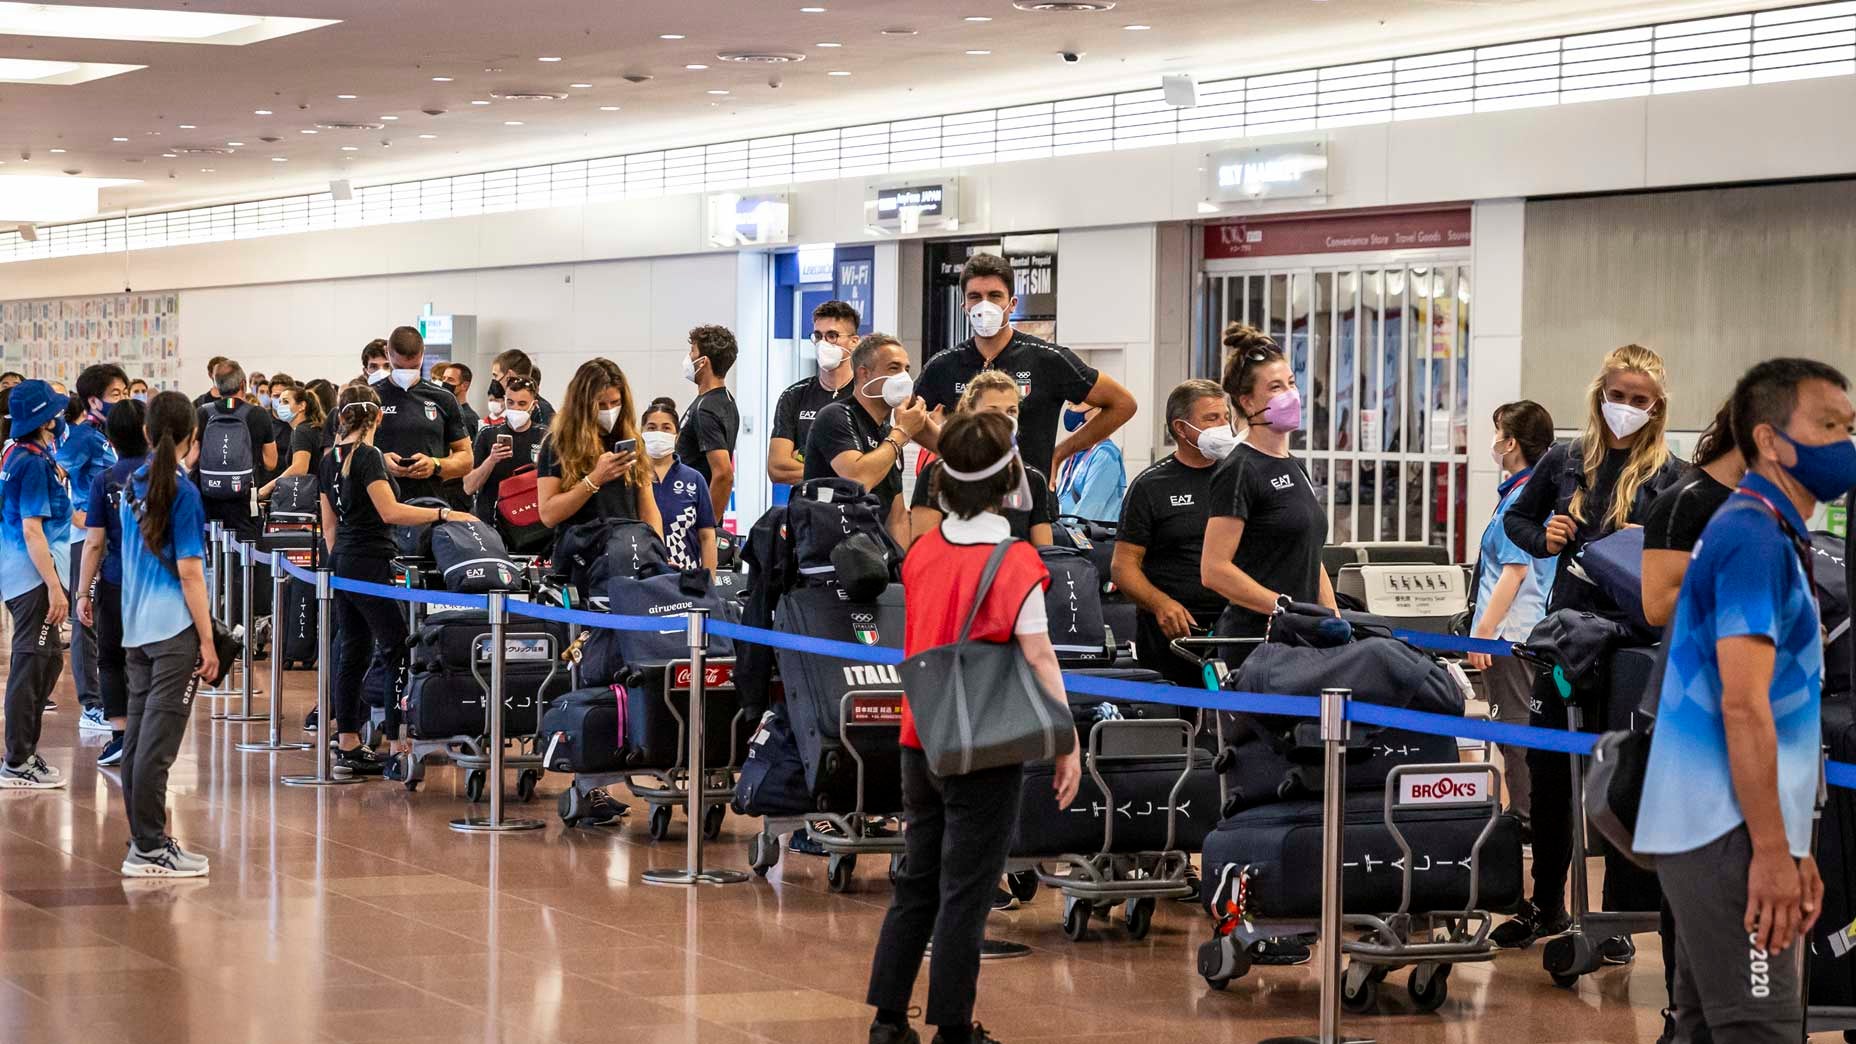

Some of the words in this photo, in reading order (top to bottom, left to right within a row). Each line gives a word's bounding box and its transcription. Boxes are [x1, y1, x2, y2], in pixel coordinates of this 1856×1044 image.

[1326, 235, 1369, 248] Convenience
[1371, 232, 1389, 245] Store
[1395, 231, 1416, 243] Travel
[1418, 230, 1441, 242] Goods
[841, 264, 869, 285] Wi-Fi
[1031, 267, 1051, 294] SIM
[799, 410, 817, 419] EA7
[208, 479, 221, 487] EA7
[1271, 474, 1290, 488] EA7
[1170, 494, 1193, 504] EA7
[631, 535, 640, 570] ITAL
[466, 569, 485, 578] EA7
[648, 602, 693, 615] airweave
[1066, 570, 1078, 633] ITALIA
[298, 597, 307, 638] ITALIA
[38, 624, 50, 646] 2020
[394, 657, 406, 710] ITALIA
[1412, 778, 1476, 799] BROOK'S
[1070, 800, 1191, 819] ITALIA
[1343, 854, 1472, 873] ITALIA
[1749, 949, 1770, 997] 2020
